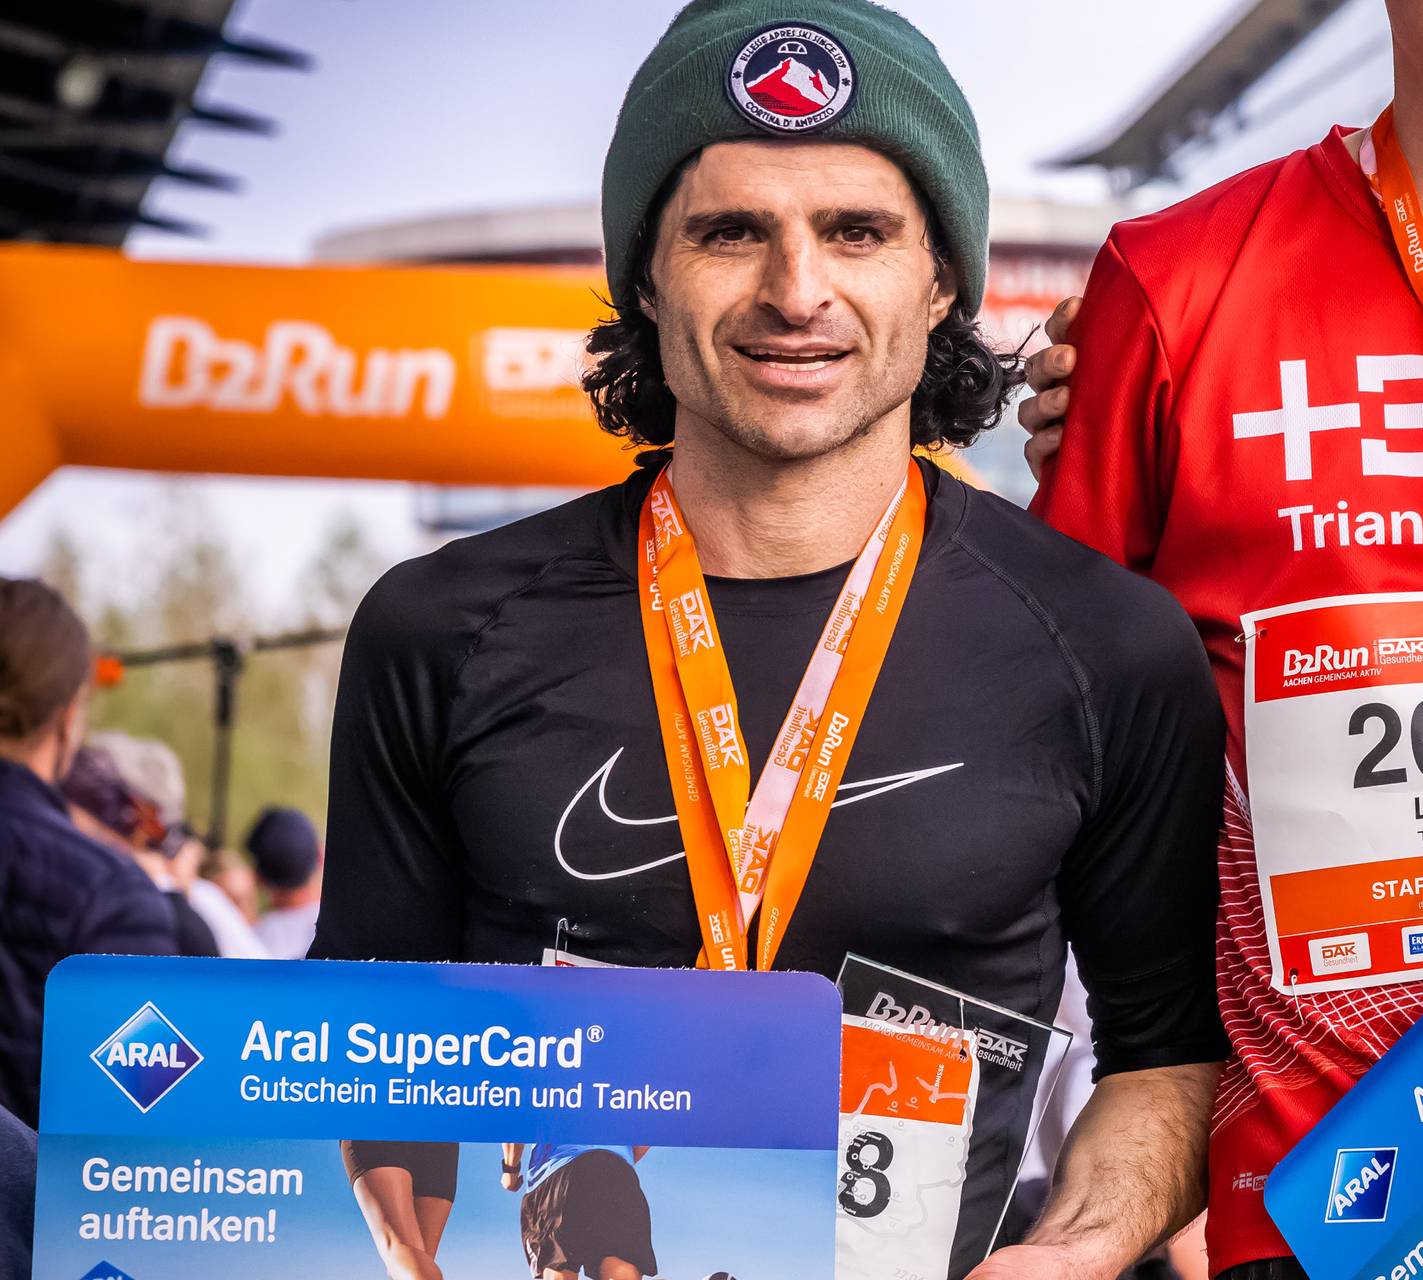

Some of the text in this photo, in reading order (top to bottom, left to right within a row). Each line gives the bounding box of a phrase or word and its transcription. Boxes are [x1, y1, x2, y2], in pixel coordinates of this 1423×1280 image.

[746, 101, 781, 126] CORTINA
[795, 107, 834, 127] AMPEZZO
[1393, 197, 1408, 223] DAK
[876, 584, 894, 614] AKTIV
[669, 598, 691, 657] Gesundheit
[680, 588, 715, 654] DAK
[1283, 644, 1369, 677] B2Run
[1283, 667, 1383, 688] AACHEN GEMEINSAM. AKTIV
[674, 713, 687, 740] AKTIV
[696, 710, 721, 771] Gesundheit
[709, 703, 744, 768] DAK
[811, 712, 849, 801] B2Run DAK
[709, 912, 724, 944] DAK
[1321, 942, 1356, 959] DAK
[1323, 955, 1358, 968] Gesundheit
[240, 1020, 329, 1063] Aral
[866, 991, 1029, 1062] B2Run DAK
[106, 1042, 186, 1068] ARAL
[240, 1075, 692, 1111] Gutschein Einkaufen und Tanken
[82, 1157, 303, 1196] Gemeinsam
[1334, 1156, 1390, 1216] ARAL
[79, 1206, 277, 1244] auftanken!
